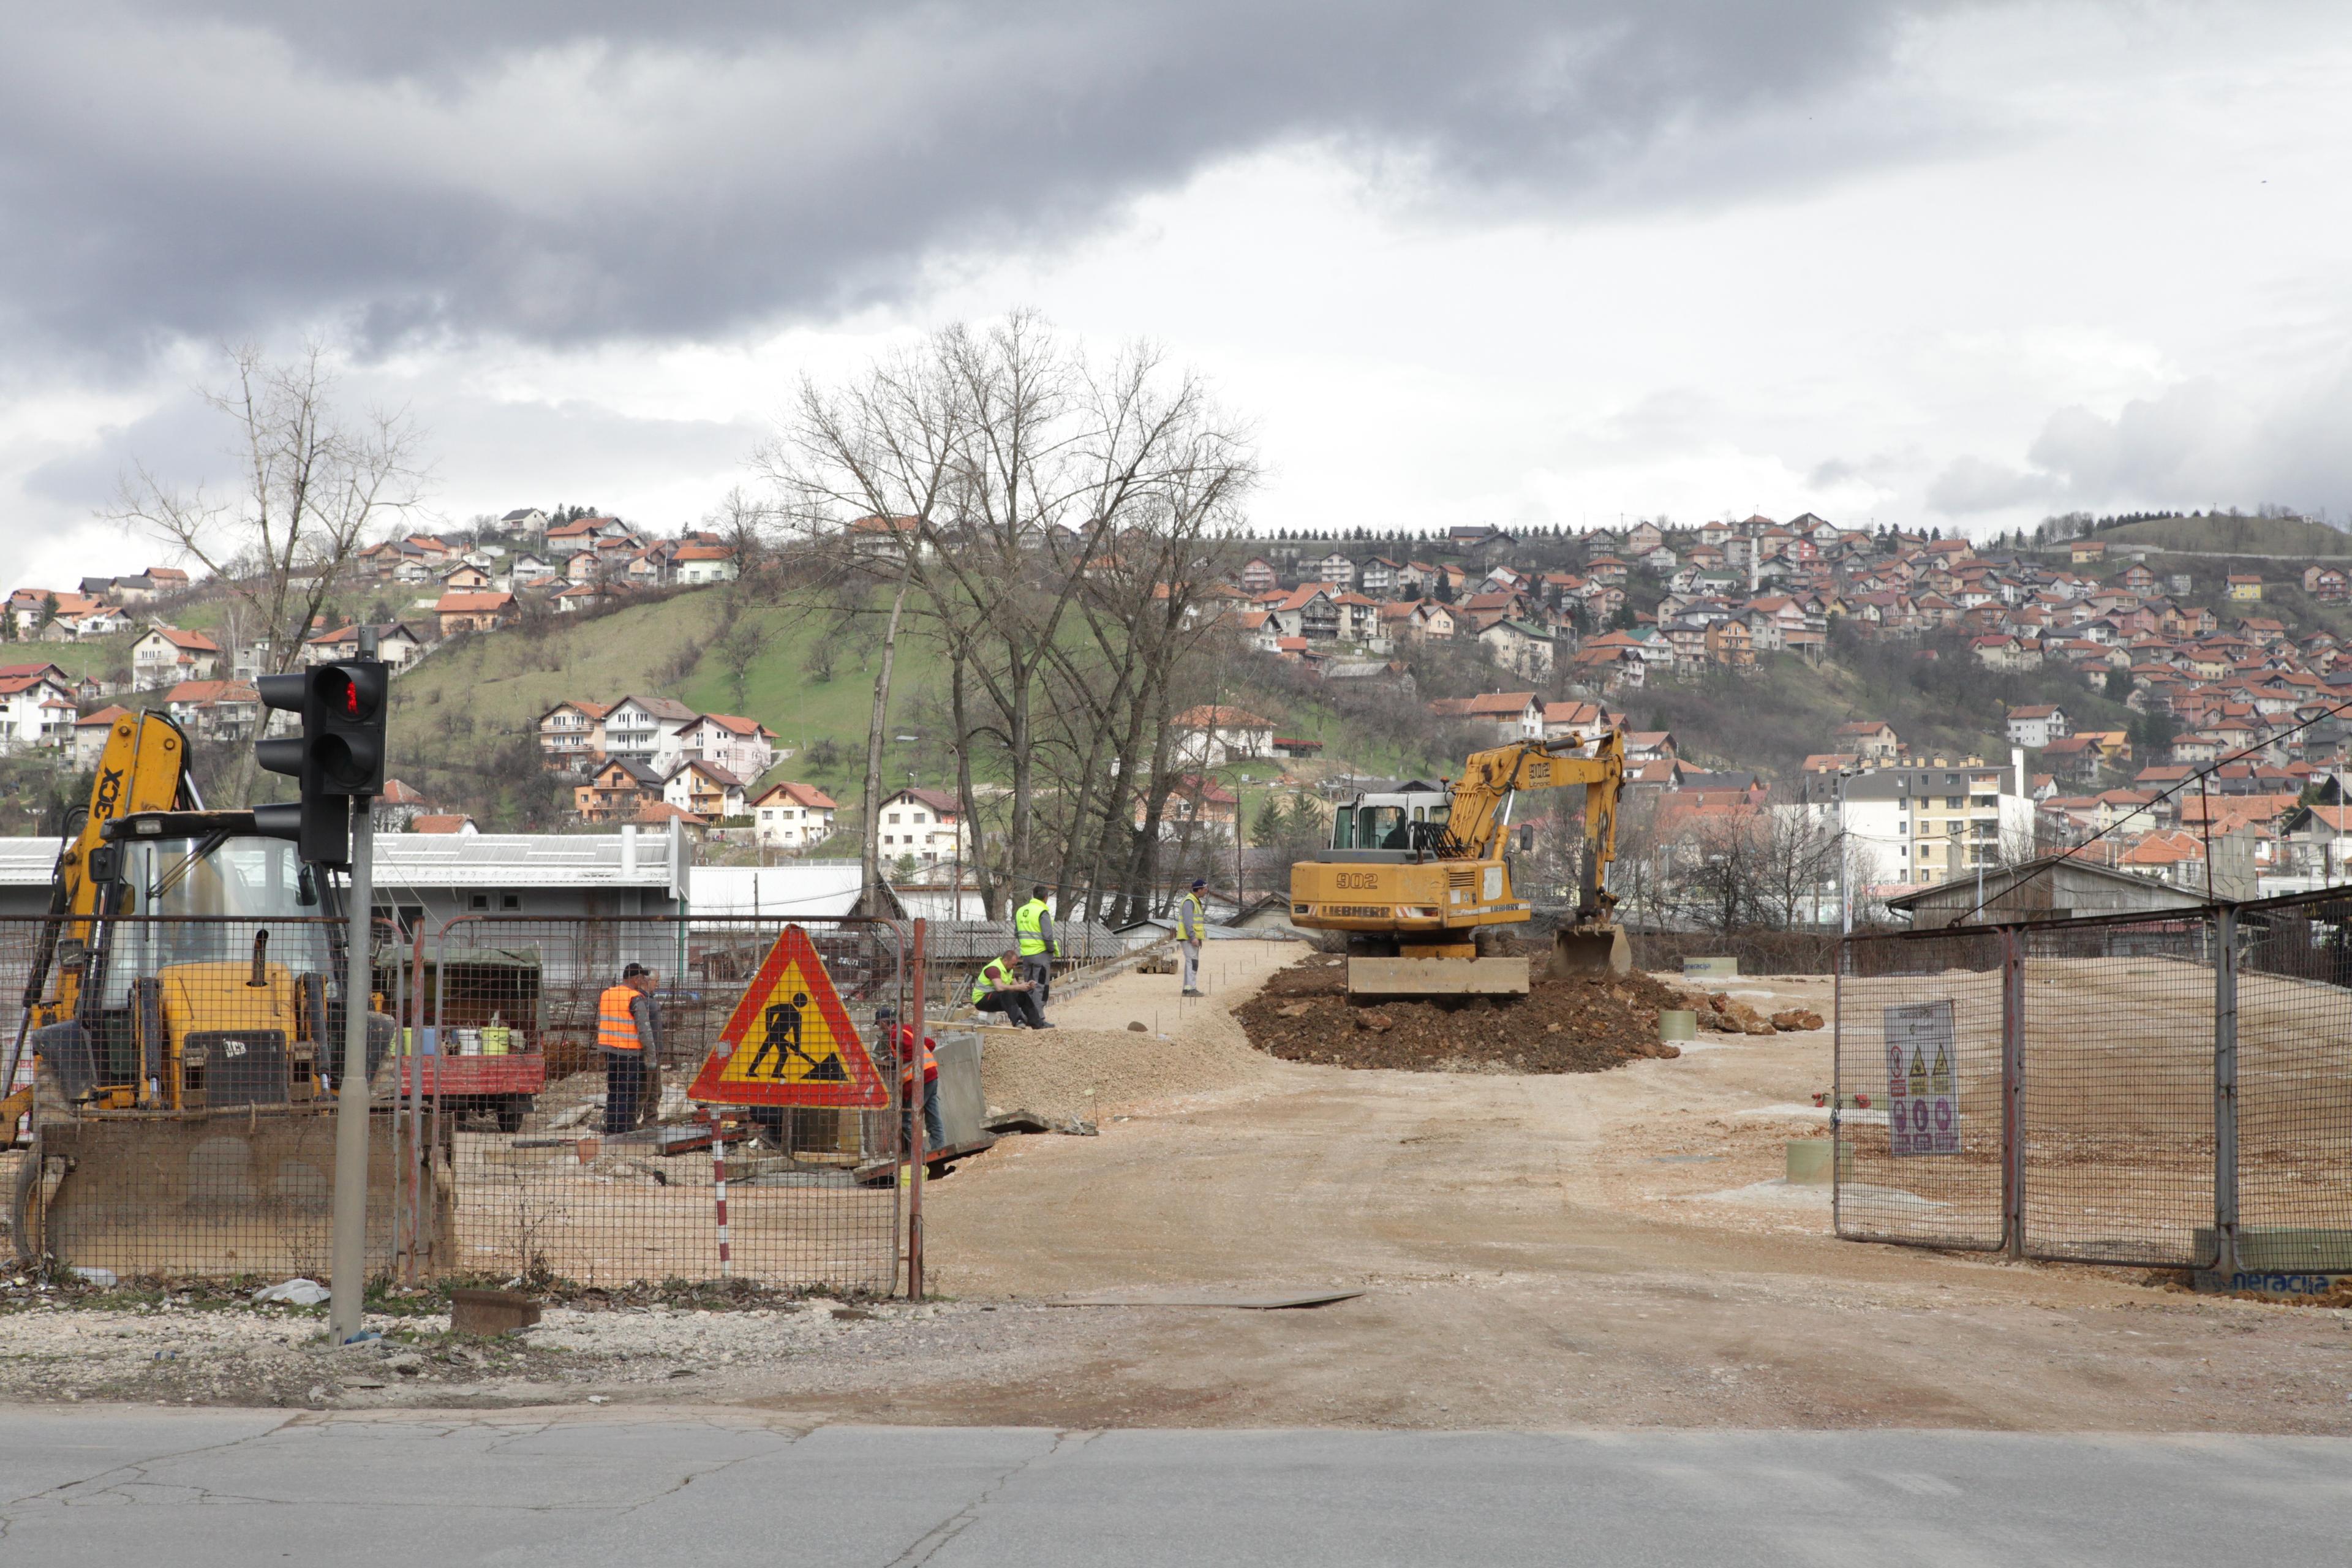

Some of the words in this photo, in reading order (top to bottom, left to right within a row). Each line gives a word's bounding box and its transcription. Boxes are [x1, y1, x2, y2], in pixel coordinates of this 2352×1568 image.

[1529, 762, 1550, 779] 902
[94, 767, 124, 820] 3CX
[1336, 872, 1378, 889] 902
[1322, 905, 1391, 918] LIEBHERR
[1490, 903, 1519, 913] LIEBHERR
[224, 1040, 247, 1058] JCB
